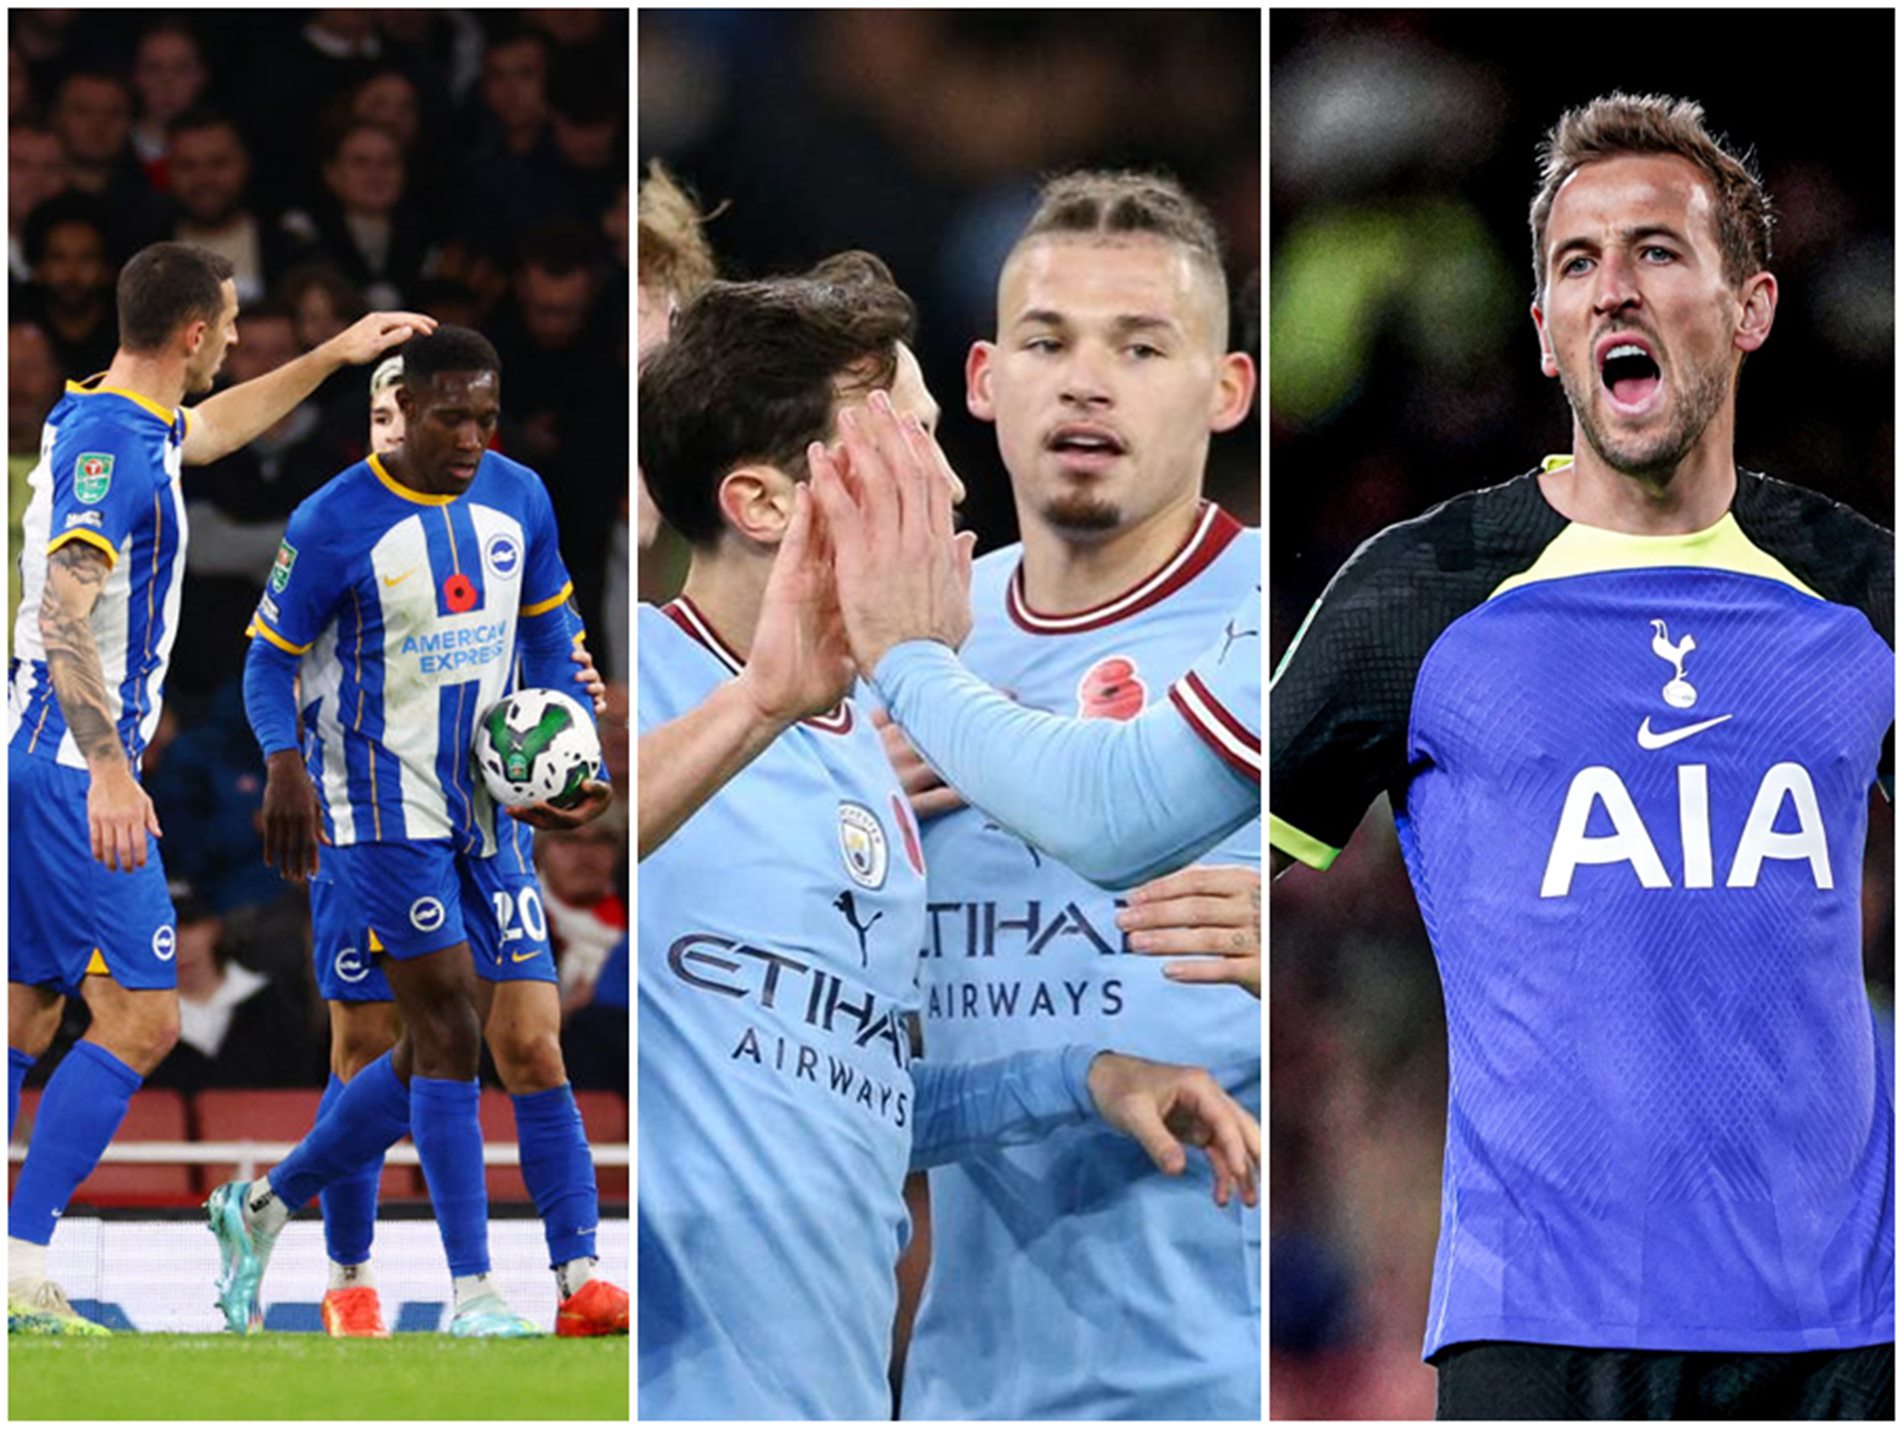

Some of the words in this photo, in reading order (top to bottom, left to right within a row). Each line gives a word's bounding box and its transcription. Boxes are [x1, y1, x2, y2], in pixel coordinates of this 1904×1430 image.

[1539, 761, 1835, 898] AIA
[919, 899, 1128, 957] TIHA
[928, 979, 1123, 1018] AIRWAYS
[731, 1027, 907, 1127] AIRWAYS
